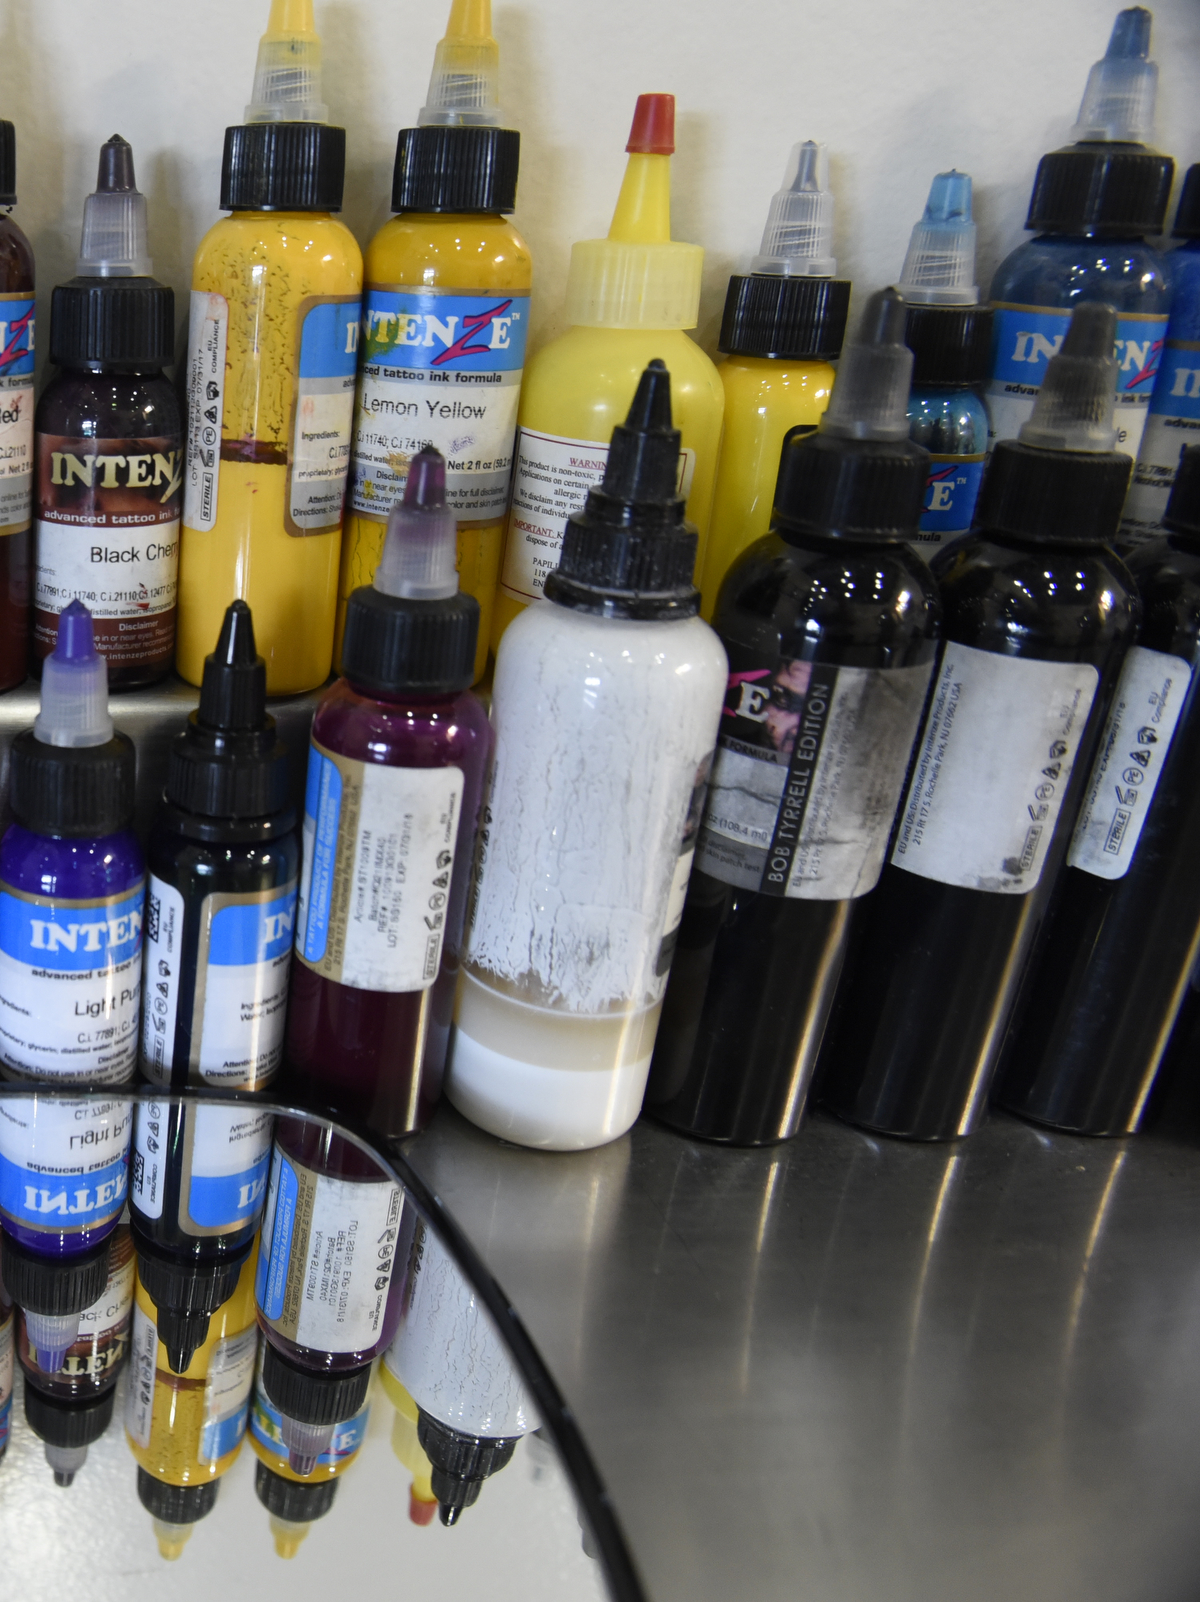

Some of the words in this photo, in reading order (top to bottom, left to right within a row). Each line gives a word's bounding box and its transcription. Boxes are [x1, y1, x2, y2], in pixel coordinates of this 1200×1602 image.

[361, 299, 513, 365] NTENZE
[211, 319, 219, 373] COMPLIANCE
[384, 368, 424, 380] tattoo
[429, 371, 449, 382] ink
[455, 372, 502, 383] formula
[363, 393, 418, 417] Lemon
[426, 400, 487, 419] Yellow
[447, 461, 465, 470] Net
[467, 460, 472, 470] 2
[569, 457, 606, 471] WARNIN
[49, 451, 182, 504] INTENZ
[203, 475, 211, 518] STERILE
[554, 488, 582, 500] allergic
[541, 507, 570, 519] individu
[555, 501, 567, 509] any
[112, 511, 156, 524] tattoo
[91, 546, 140, 563] Black
[797, 683, 829, 761] EDITION
[924, 720, 939, 752] Intenze
[912, 830, 924, 845] 215
[919, 807, 929, 818] 17
[925, 763, 941, 798] Rochelle
[950, 682, 962, 701] USA
[921, 752, 931, 763] by
[909, 764, 928, 810] Distributed
[778, 768, 811, 838] TYRRELL
[902, 825, 912, 841] and
[898, 841, 907, 854] EU
[768, 846, 790, 883] BOB
